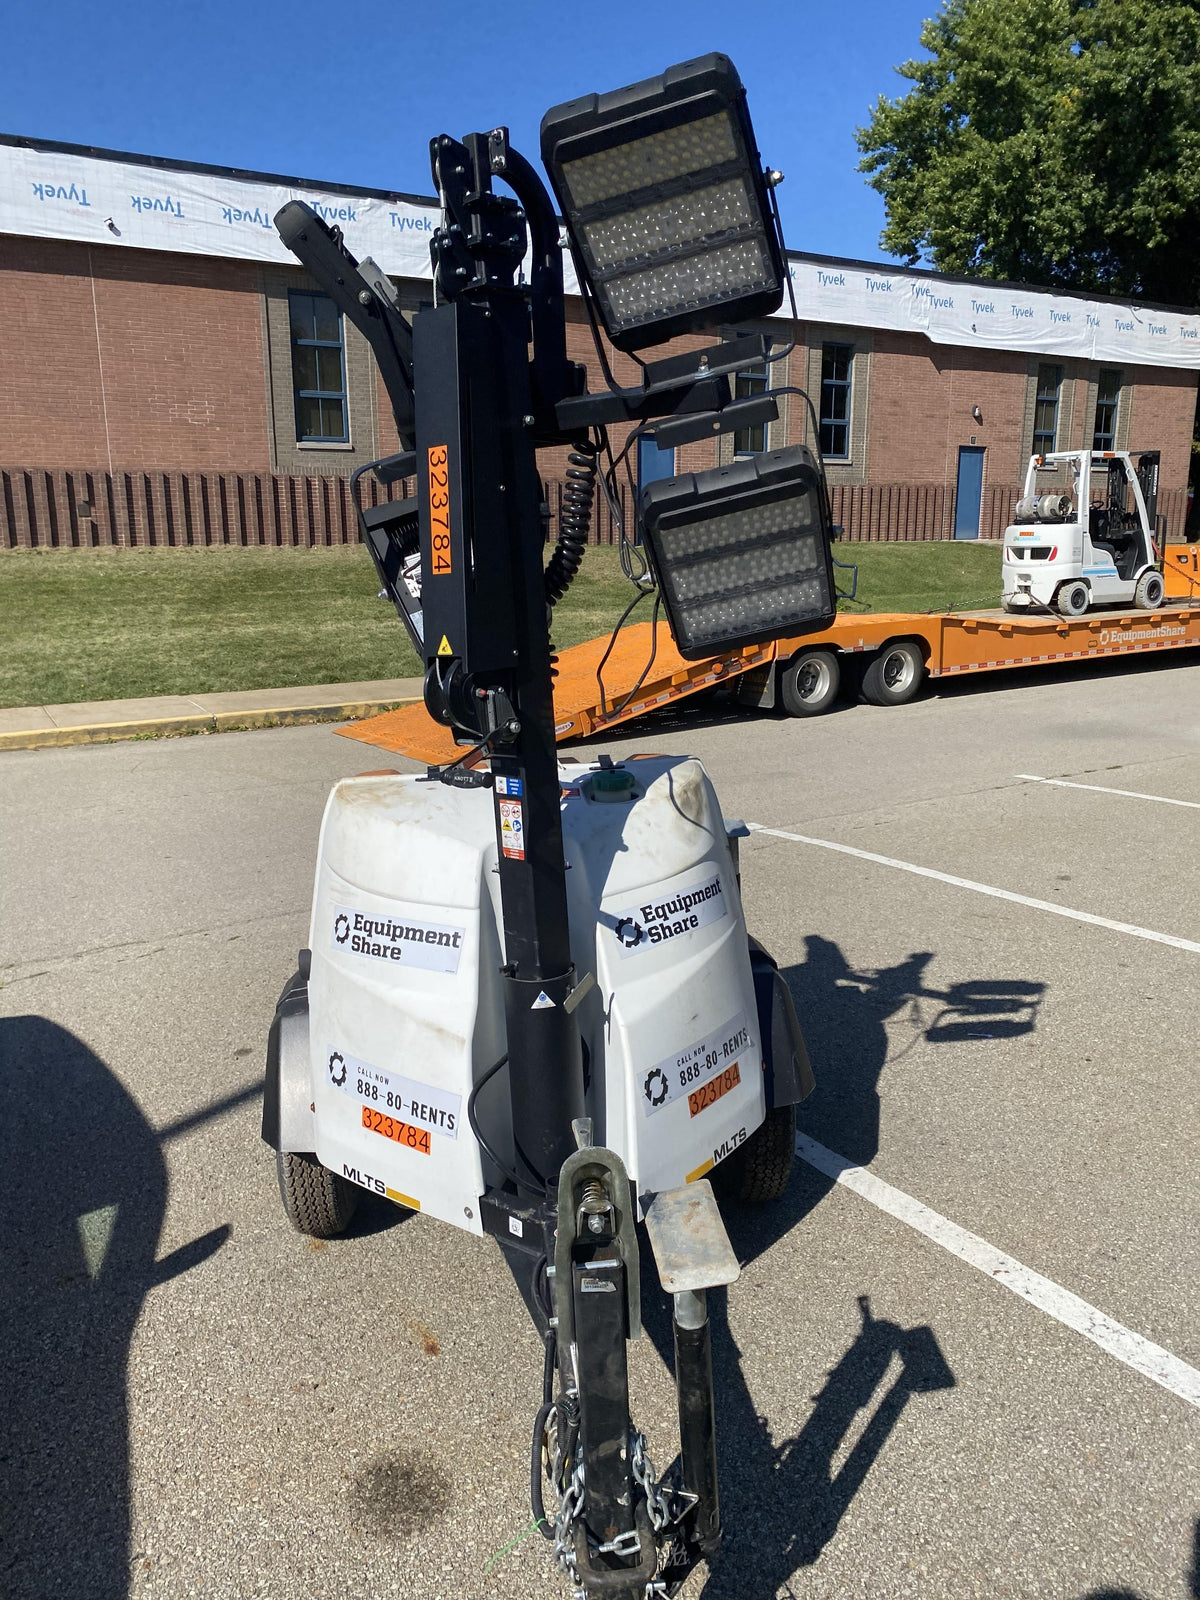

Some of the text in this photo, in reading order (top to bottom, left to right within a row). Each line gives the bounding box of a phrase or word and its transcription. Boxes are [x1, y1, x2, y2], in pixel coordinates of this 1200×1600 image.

[32, 182, 90, 206] Tyvek
[130, 195, 185, 219] Tyvek
[222, 207, 273, 229] Tyvek
[310, 201, 357, 222] Tyvek
[389, 212, 432, 232] Tyvek
[817, 271, 845, 286] Tyvek
[865, 277, 892, 292] Tyvek
[911, 283, 931, 299] Tyve
[929, 295, 954, 309] Tyvek
[971, 300, 995, 314] Tyvek
[1011, 305, 1034, 319] Tyvek
[1049, 310, 1071, 323] Tyvek
[1114, 319, 1135, 332] Tyvek
[1148, 323, 1167, 335] Tyvek
[1180, 326, 1198, 338] Tyvek
[429, 449, 451, 572] 323784
[1110, 626, 1186, 644] EquipmentShare
[640, 879, 722, 924] Equipment
[353, 913, 461, 948] Equipment
[647, 914, 699, 944] Share
[351, 934, 402, 960] Share
[677, 1044, 706, 1067] CALL NOW
[679, 1027, 748, 1086] 888-80-RENTS
[357, 1066, 390, 1086] CALL NOW
[690, 1065, 741, 1115] 323784
[357, 1078, 456, 1130] 888-80-RENTS
[363, 1107, 430, 1153] 323784
[713, 1127, 747, 1163] MLTS
[343, 1163, 386, 1194] MLTS
